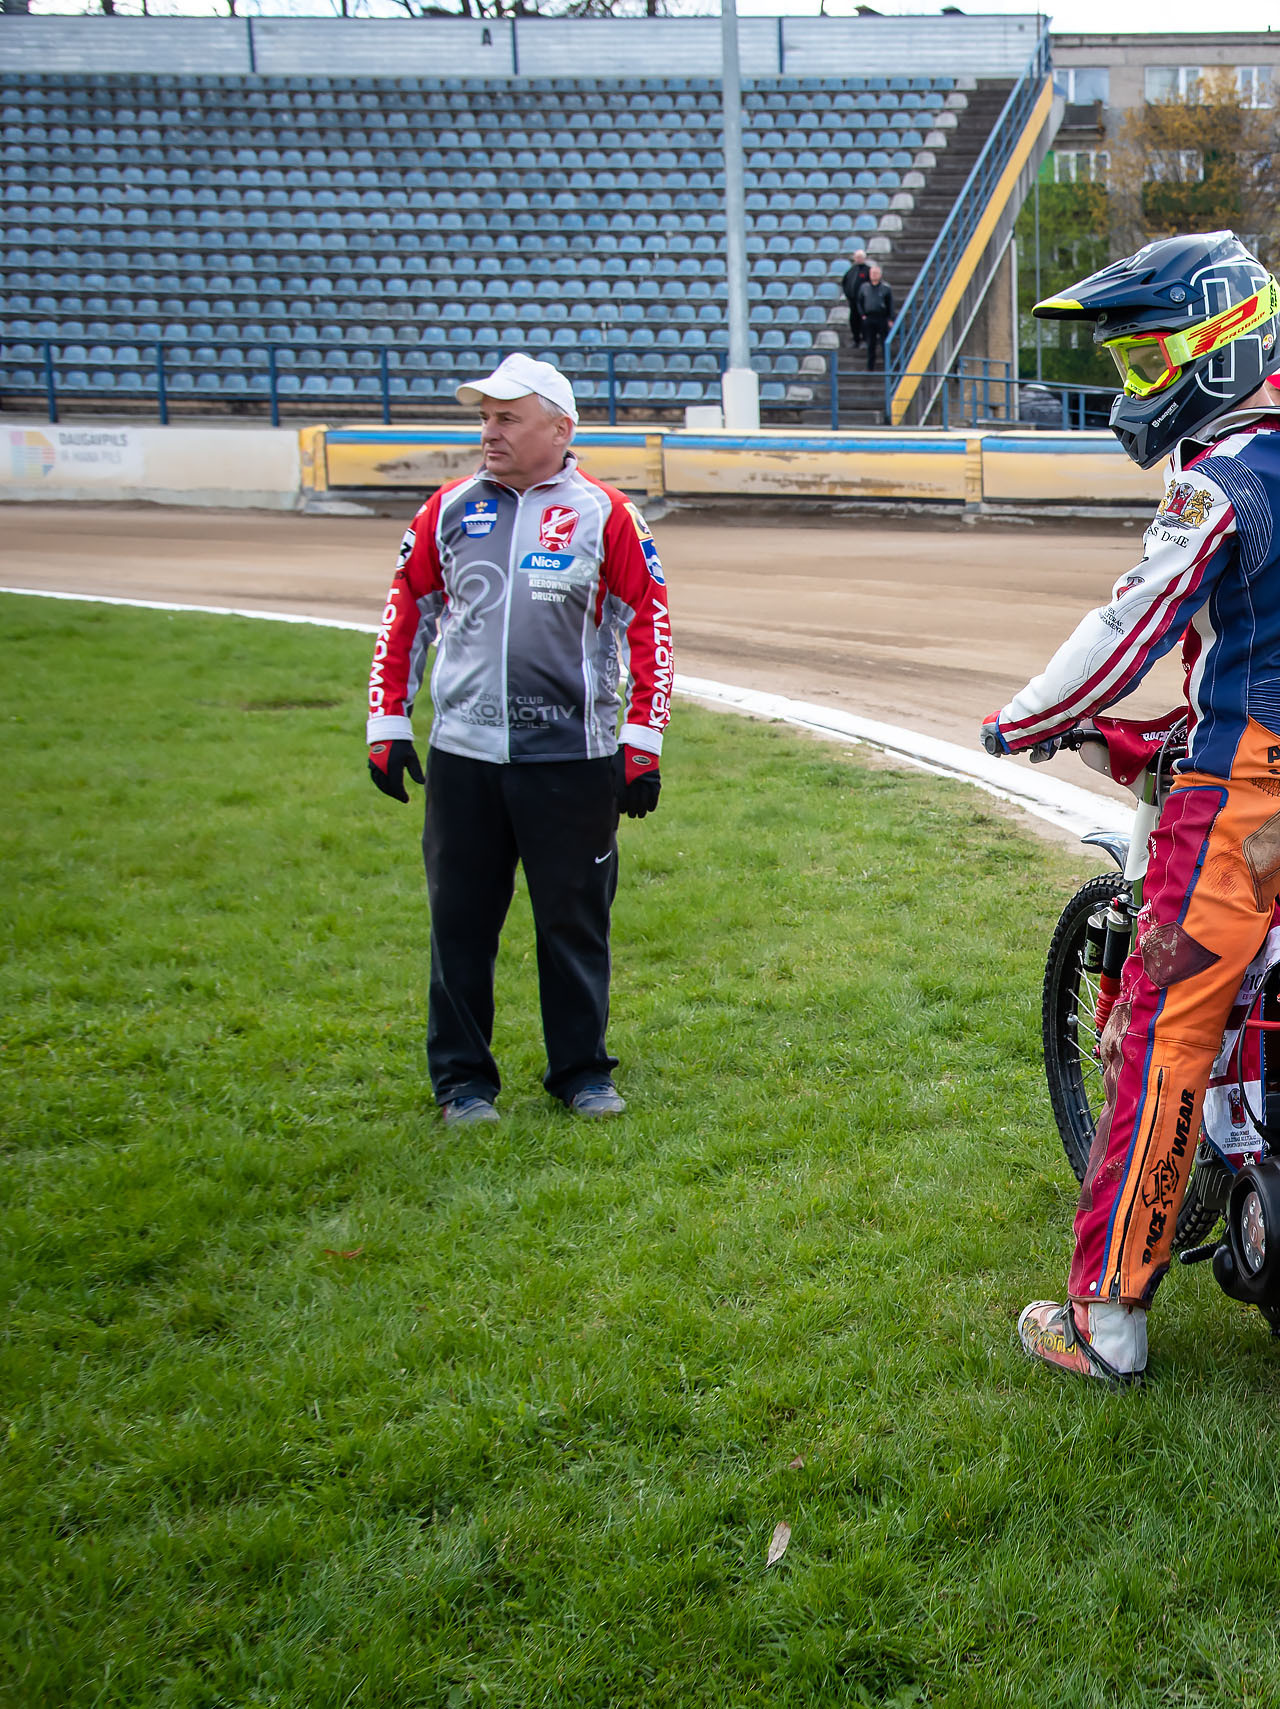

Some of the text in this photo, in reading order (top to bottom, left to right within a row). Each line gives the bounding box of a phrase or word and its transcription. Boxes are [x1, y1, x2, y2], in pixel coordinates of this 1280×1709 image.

[1219, 311, 1266, 345] PROGRIP
[531, 555, 561, 569] Nice
[528, 579, 572, 592] KIEROWNIK
[516, 695, 544, 705] CLUB
[458, 699, 577, 722] OKOMOTIV
[1141, 1088, 1196, 1267] RACE WEAR
